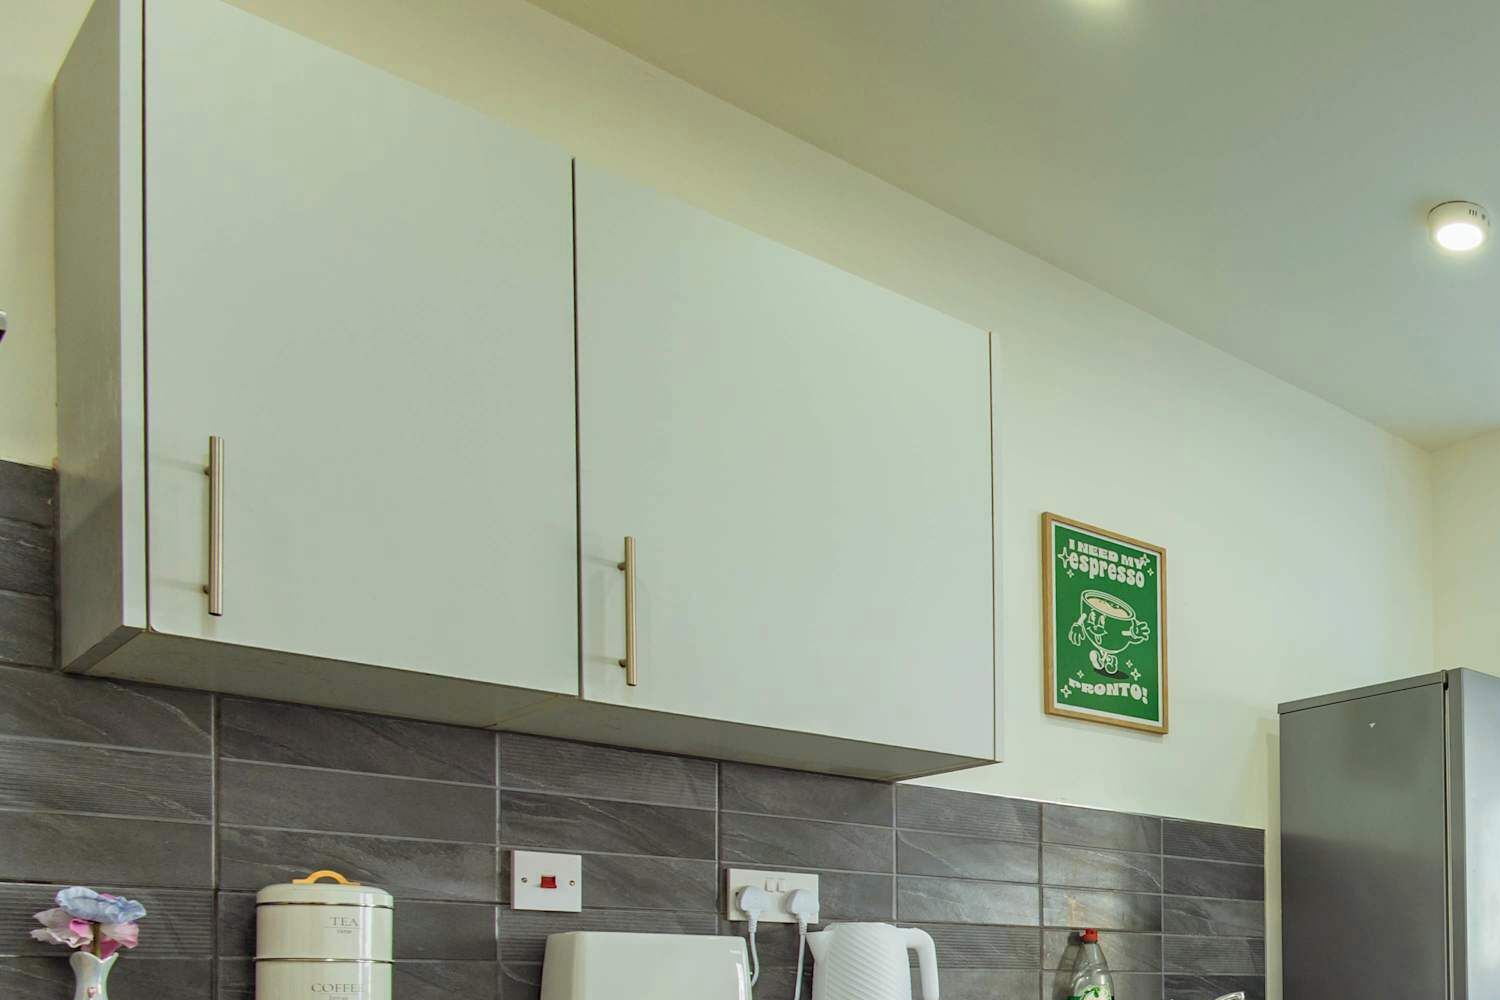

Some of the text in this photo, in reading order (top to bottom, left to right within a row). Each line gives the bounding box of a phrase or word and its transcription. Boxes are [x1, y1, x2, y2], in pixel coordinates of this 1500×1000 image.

[1069, 538, 1145, 570] I NEED MY
[1069, 552, 1145, 588] espresso
[1068, 677, 1148, 704] PRONTO!
[330, 916, 359, 927] TEA
